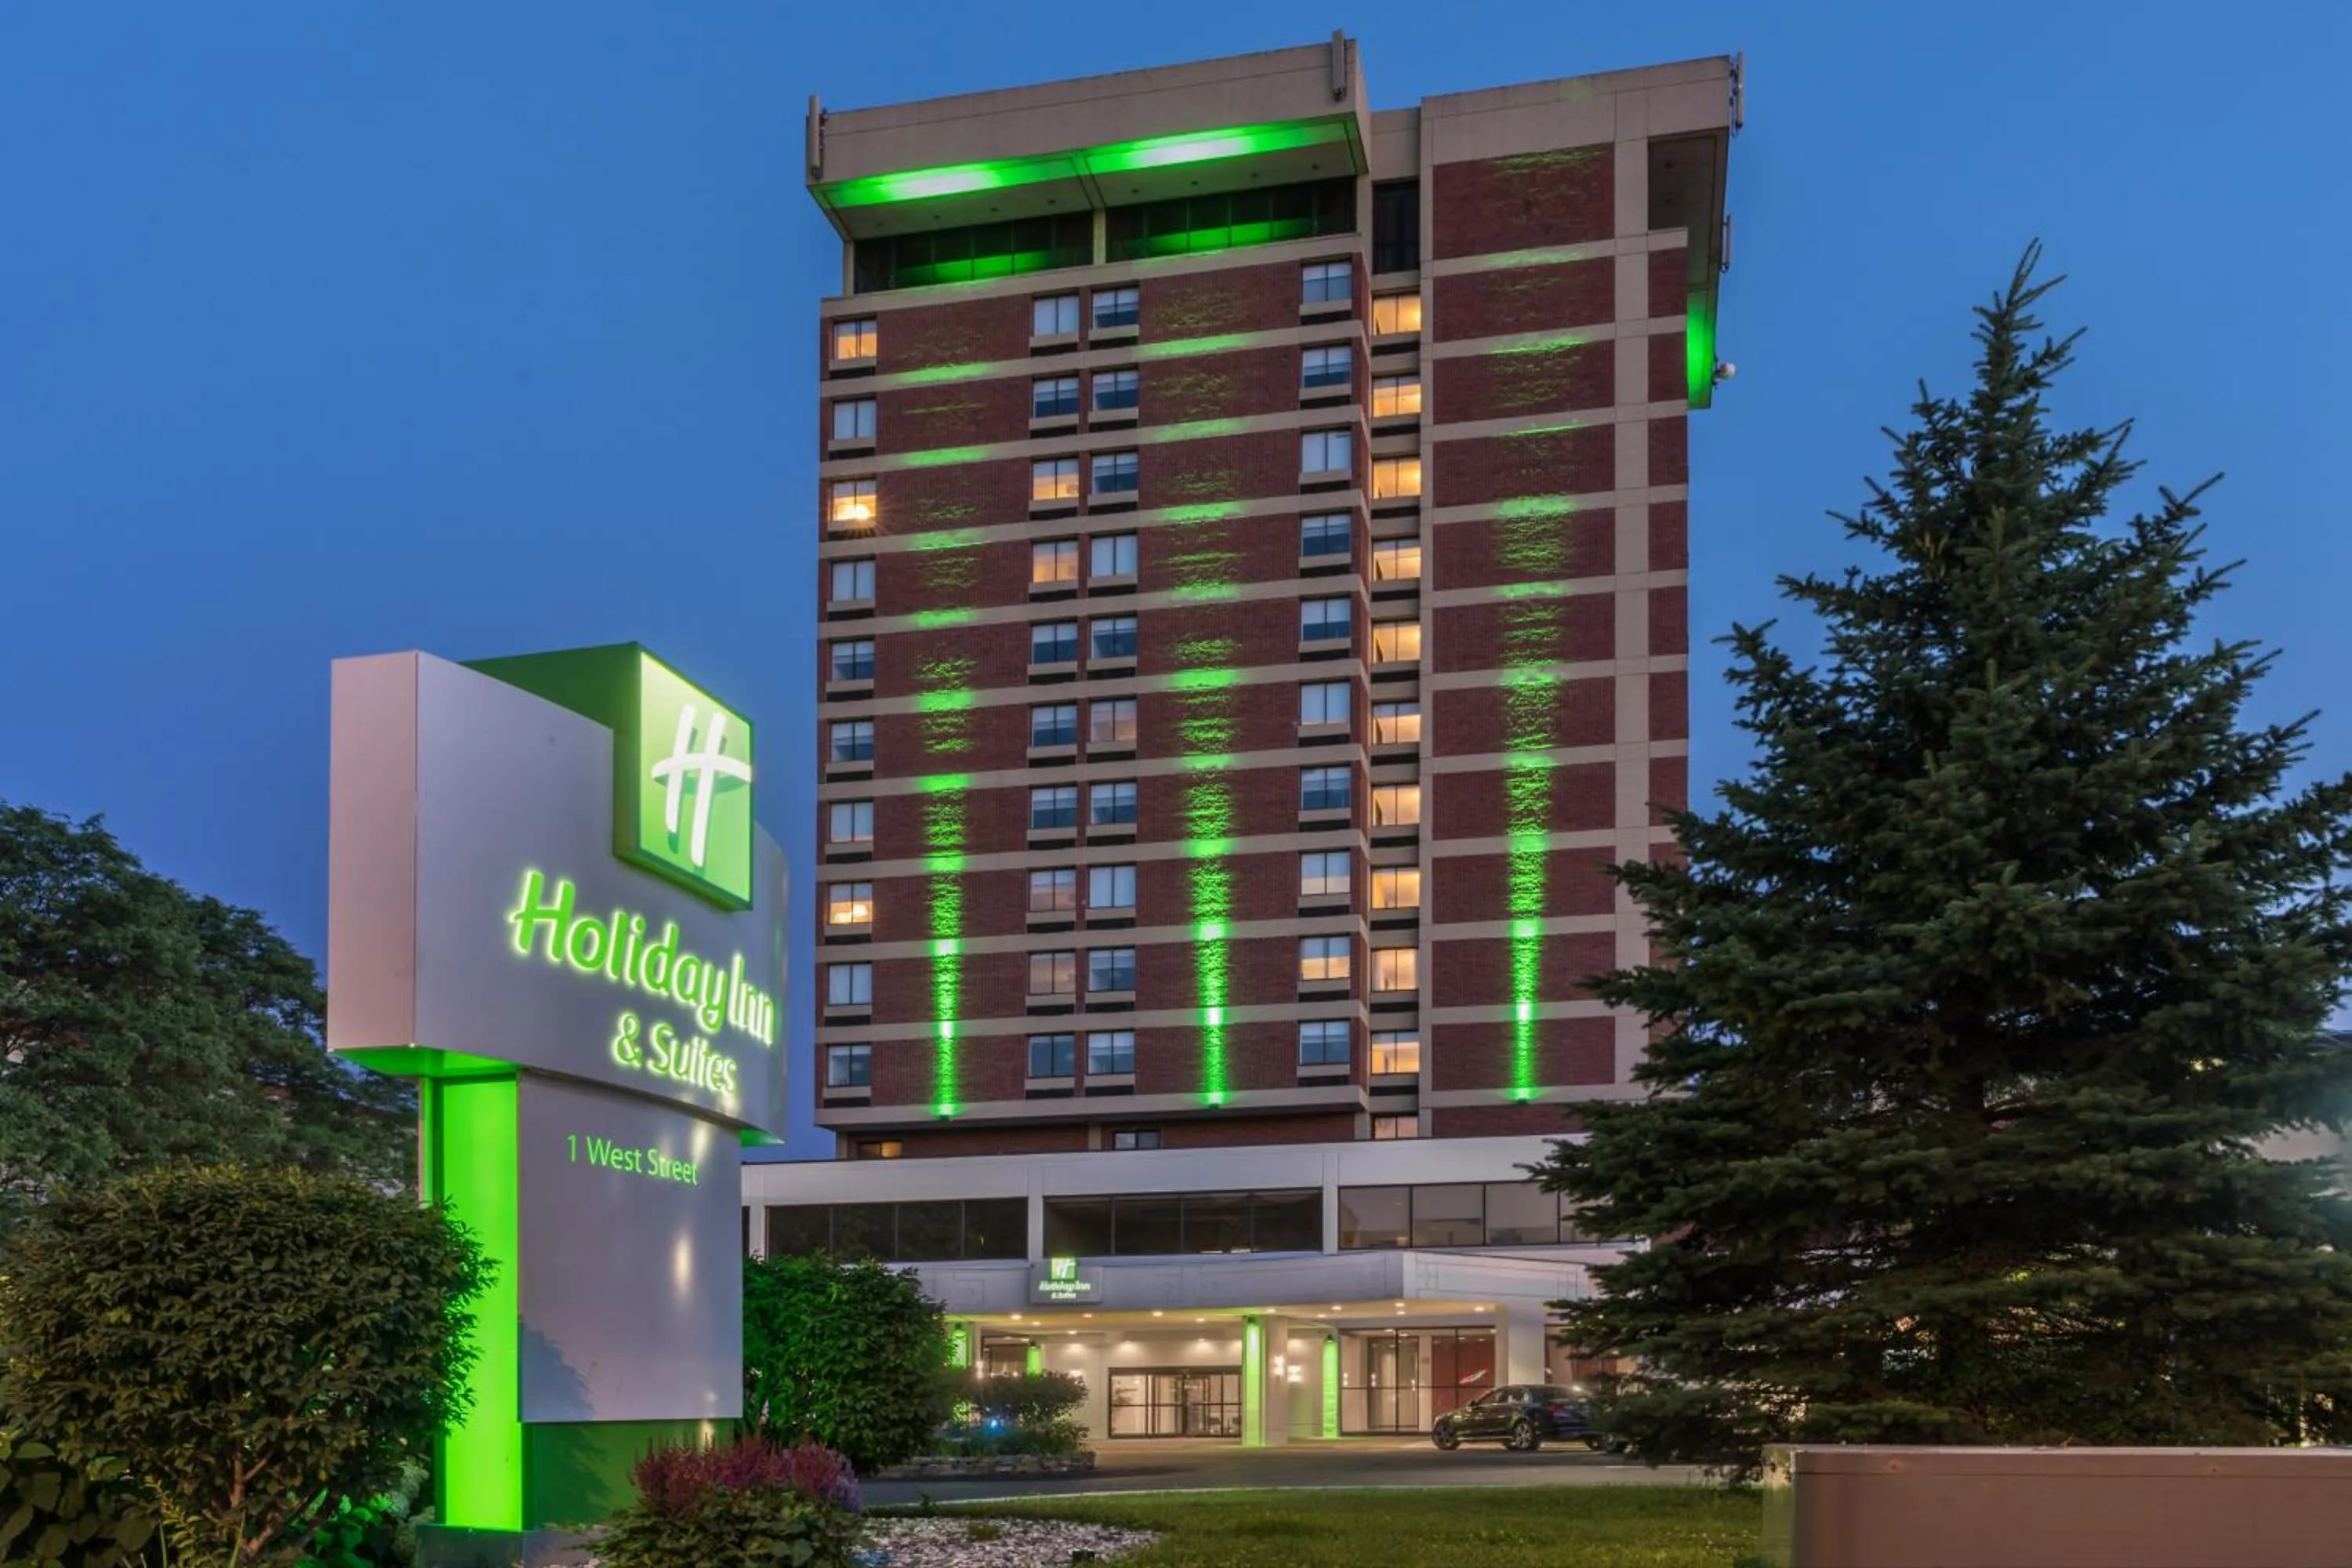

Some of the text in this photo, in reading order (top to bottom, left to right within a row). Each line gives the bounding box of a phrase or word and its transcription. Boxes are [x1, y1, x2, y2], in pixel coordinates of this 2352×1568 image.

[508, 869, 775, 1047] Holiday Inn
[612, 1011, 738, 1093] & Suites
[567, 1134, 699, 1185] 1 West Street
